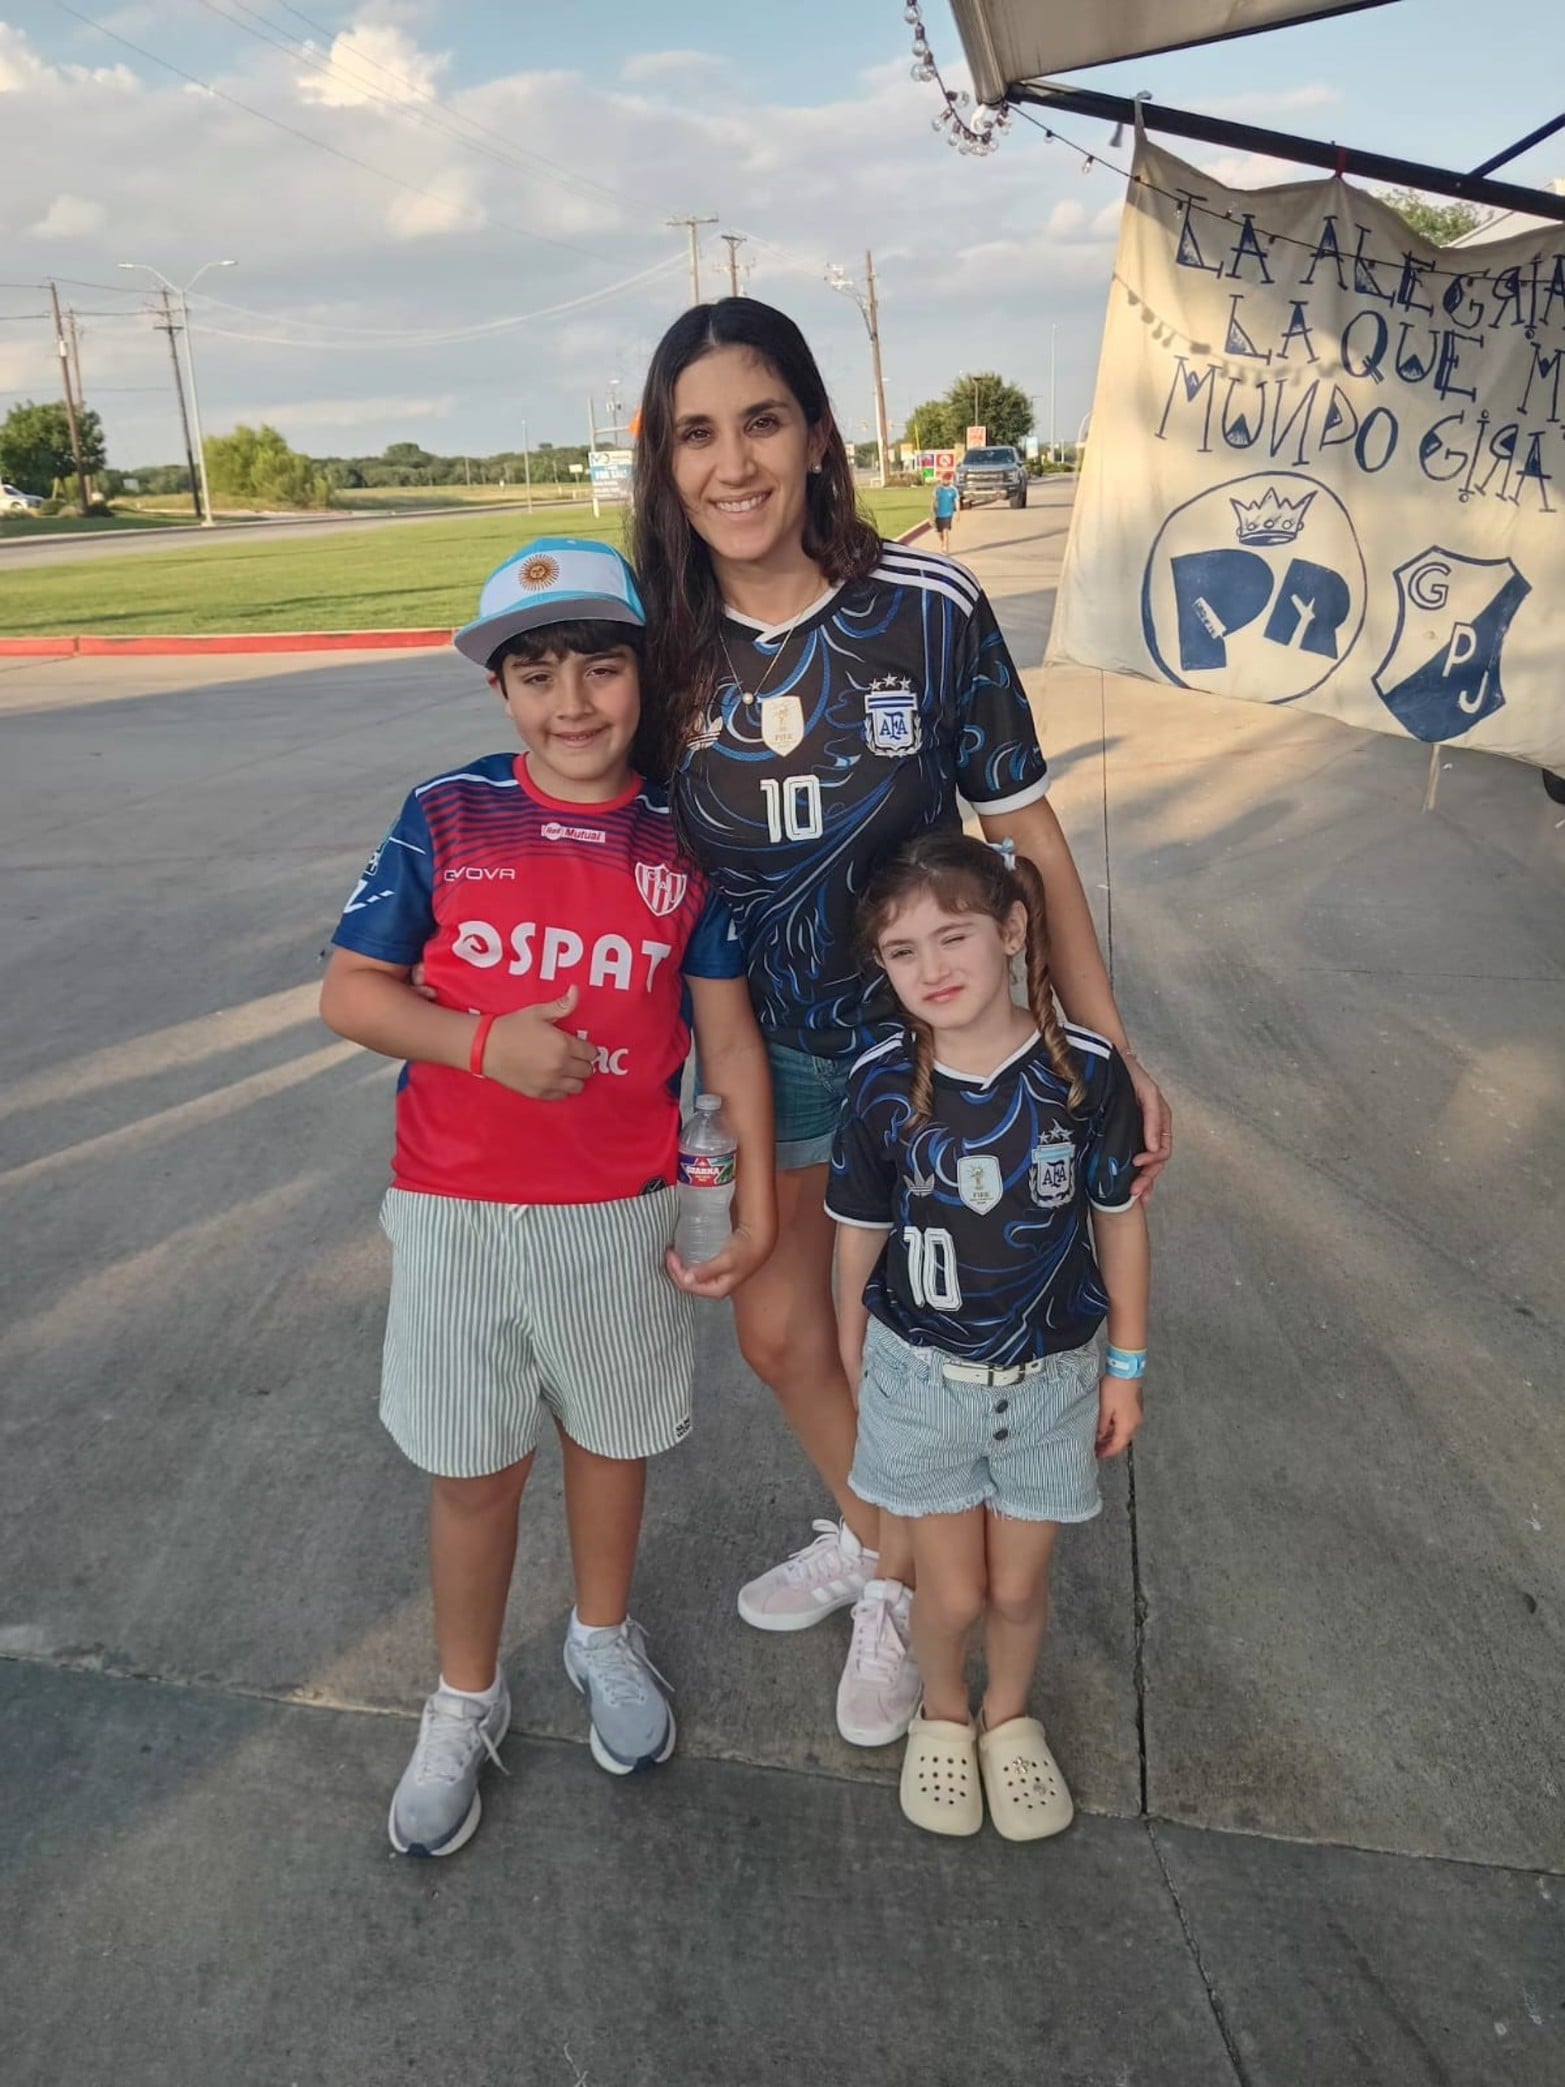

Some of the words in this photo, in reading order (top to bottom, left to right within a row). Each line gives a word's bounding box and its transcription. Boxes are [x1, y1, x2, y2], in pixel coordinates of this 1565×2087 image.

[1176, 189, 1275, 284] LA
[1224, 294, 1319, 365] LA
[1340, 310, 1484, 402] QUE
[1154, 355, 1399, 474] MUNDO
[564, 828, 602, 841] Mutual
[759, 774, 824, 844] 10
[451, 920, 673, 993] OSPAT
[902, 1225, 964, 1312] 10
